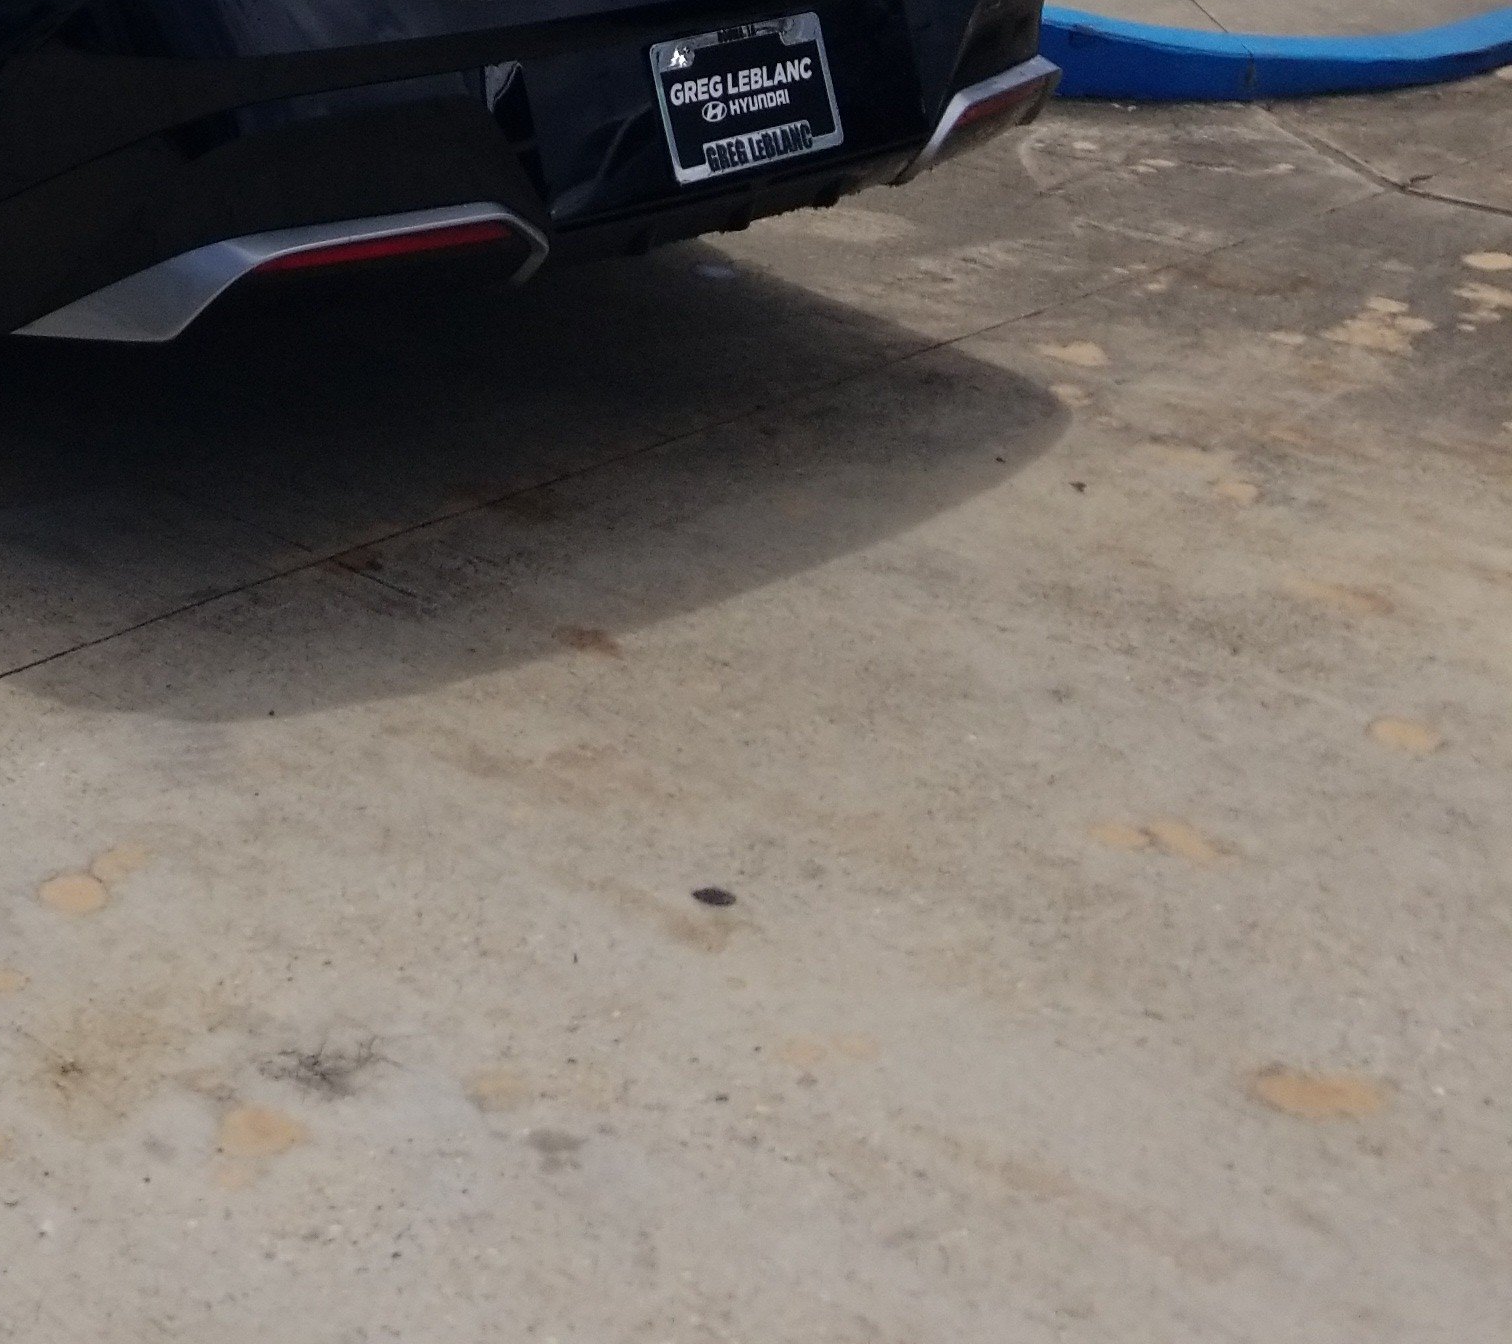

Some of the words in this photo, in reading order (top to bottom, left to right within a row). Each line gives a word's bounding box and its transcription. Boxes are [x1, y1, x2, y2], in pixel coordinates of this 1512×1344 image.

[670, 75, 723, 106] GREG
[726, 57, 813, 94] LEBLANC
[729, 89, 790, 116] HYUNDAI
[705, 138, 749, 173] GREG
